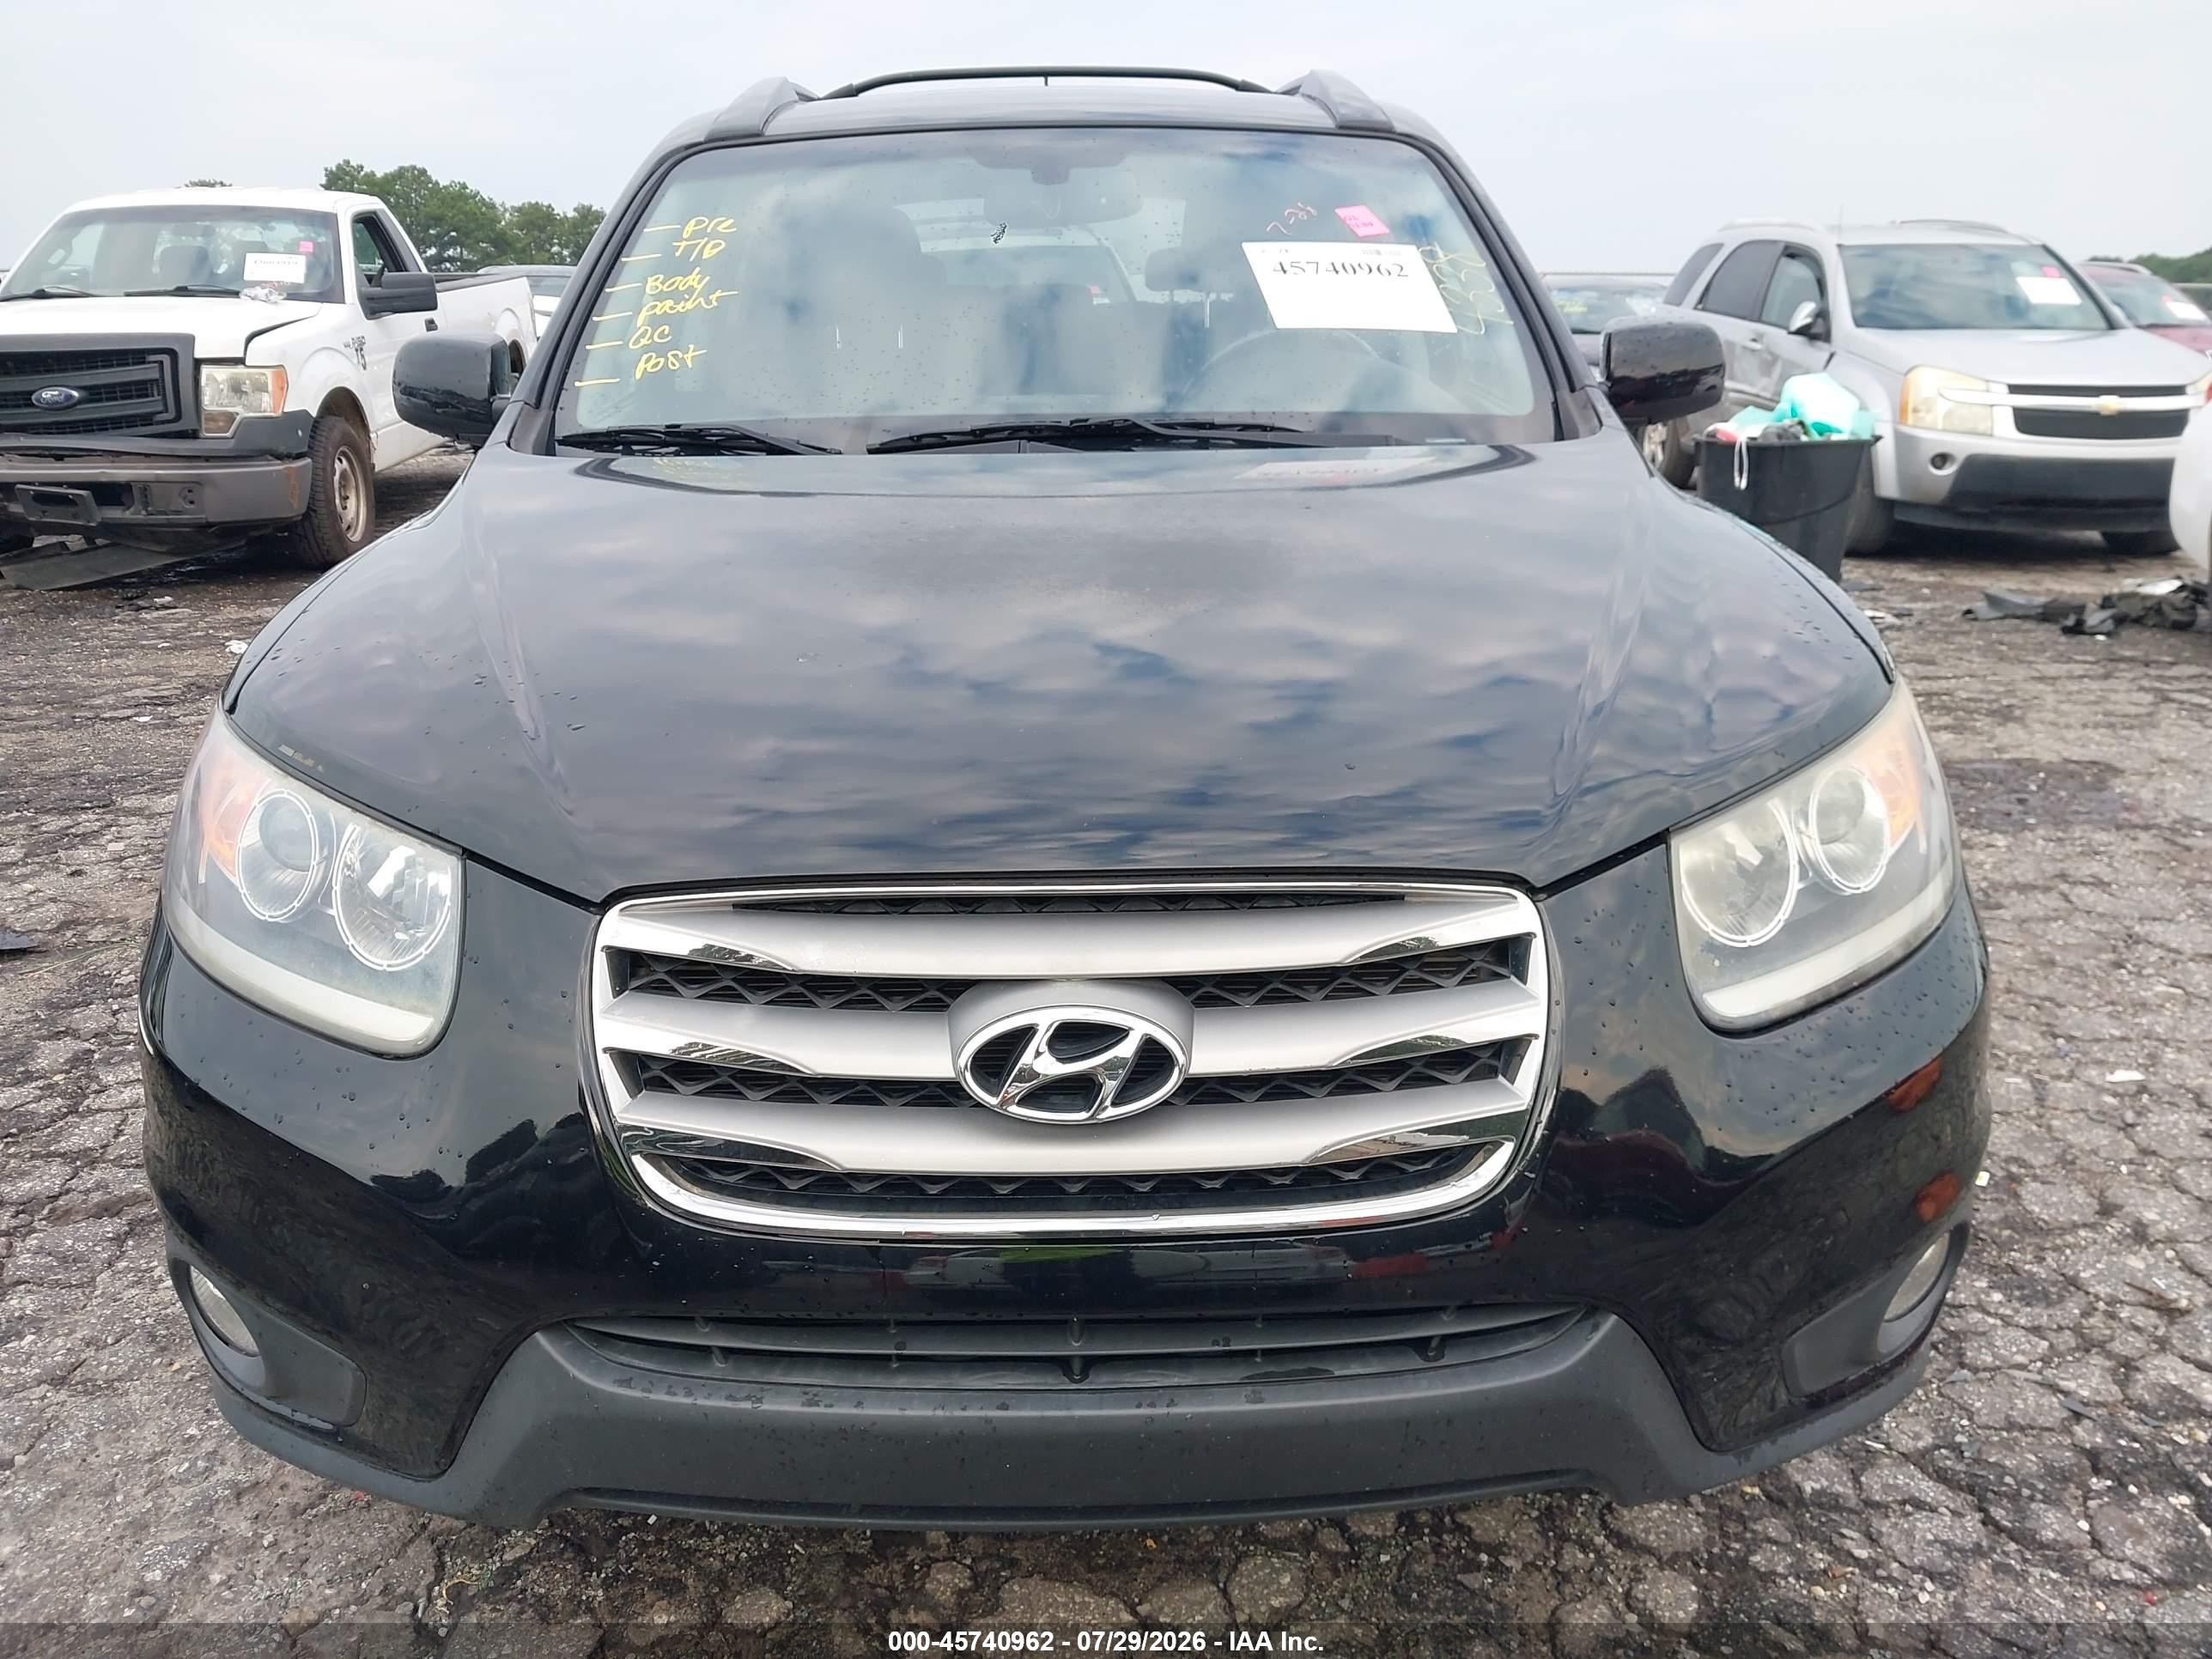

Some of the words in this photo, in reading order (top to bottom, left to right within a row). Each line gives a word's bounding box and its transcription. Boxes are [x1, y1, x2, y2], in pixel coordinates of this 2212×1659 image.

[1273, 260, 1409, 278] 45740962
[645, 266, 710, 299] Body
[628, 325, 672, 349] QC
